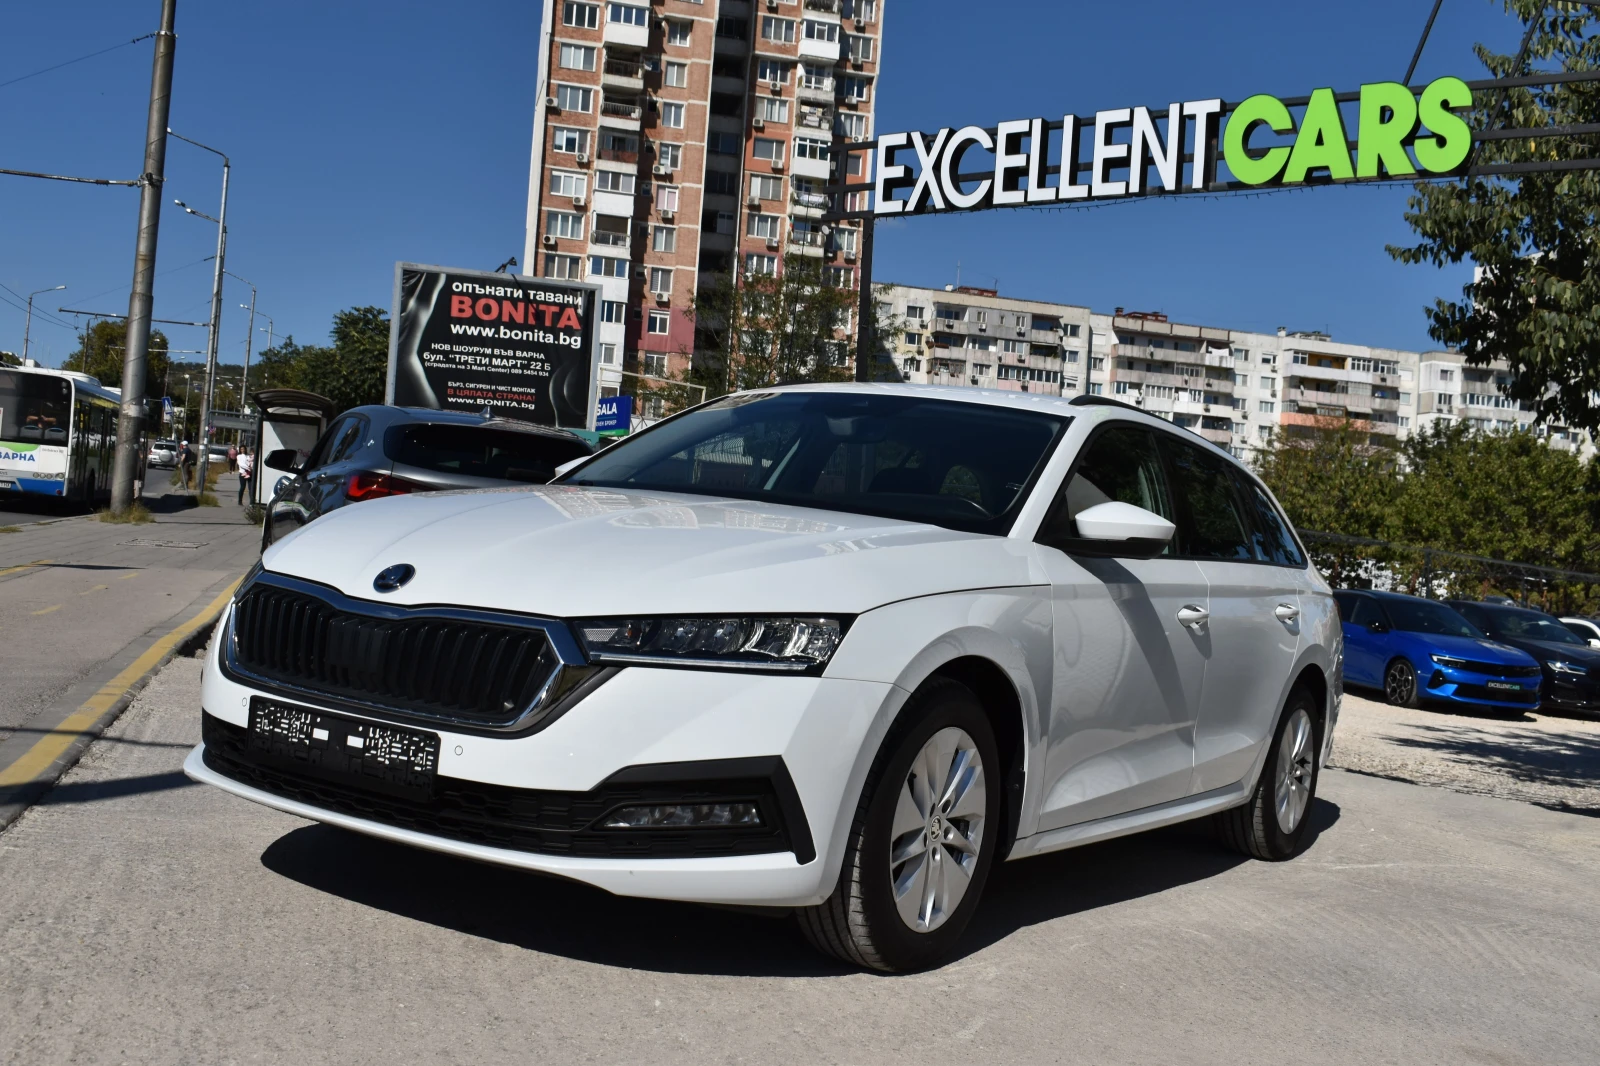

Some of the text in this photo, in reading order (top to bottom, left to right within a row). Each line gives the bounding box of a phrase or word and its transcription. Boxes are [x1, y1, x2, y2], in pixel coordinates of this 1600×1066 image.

[452, 281, 582, 306] опънати тавани
[450, 294, 582, 330] BONITA
[450, 323, 582, 349] www.bonita.bg
[431, 343, 546, 360] НОВ ШОУРУМ ВЪВ ВАРНА
[423, 351, 446, 362] бул.
[530, 361, 542, 370] 22
[544, 362, 551, 371] Б
[456, 389, 494, 398] ЦЯЛАТА
[495, 392, 536, 401] СТРАНА!
[511, 386, 536, 394] МОНТАЖ
[447, 397, 535, 410] www.BONITA.bg
